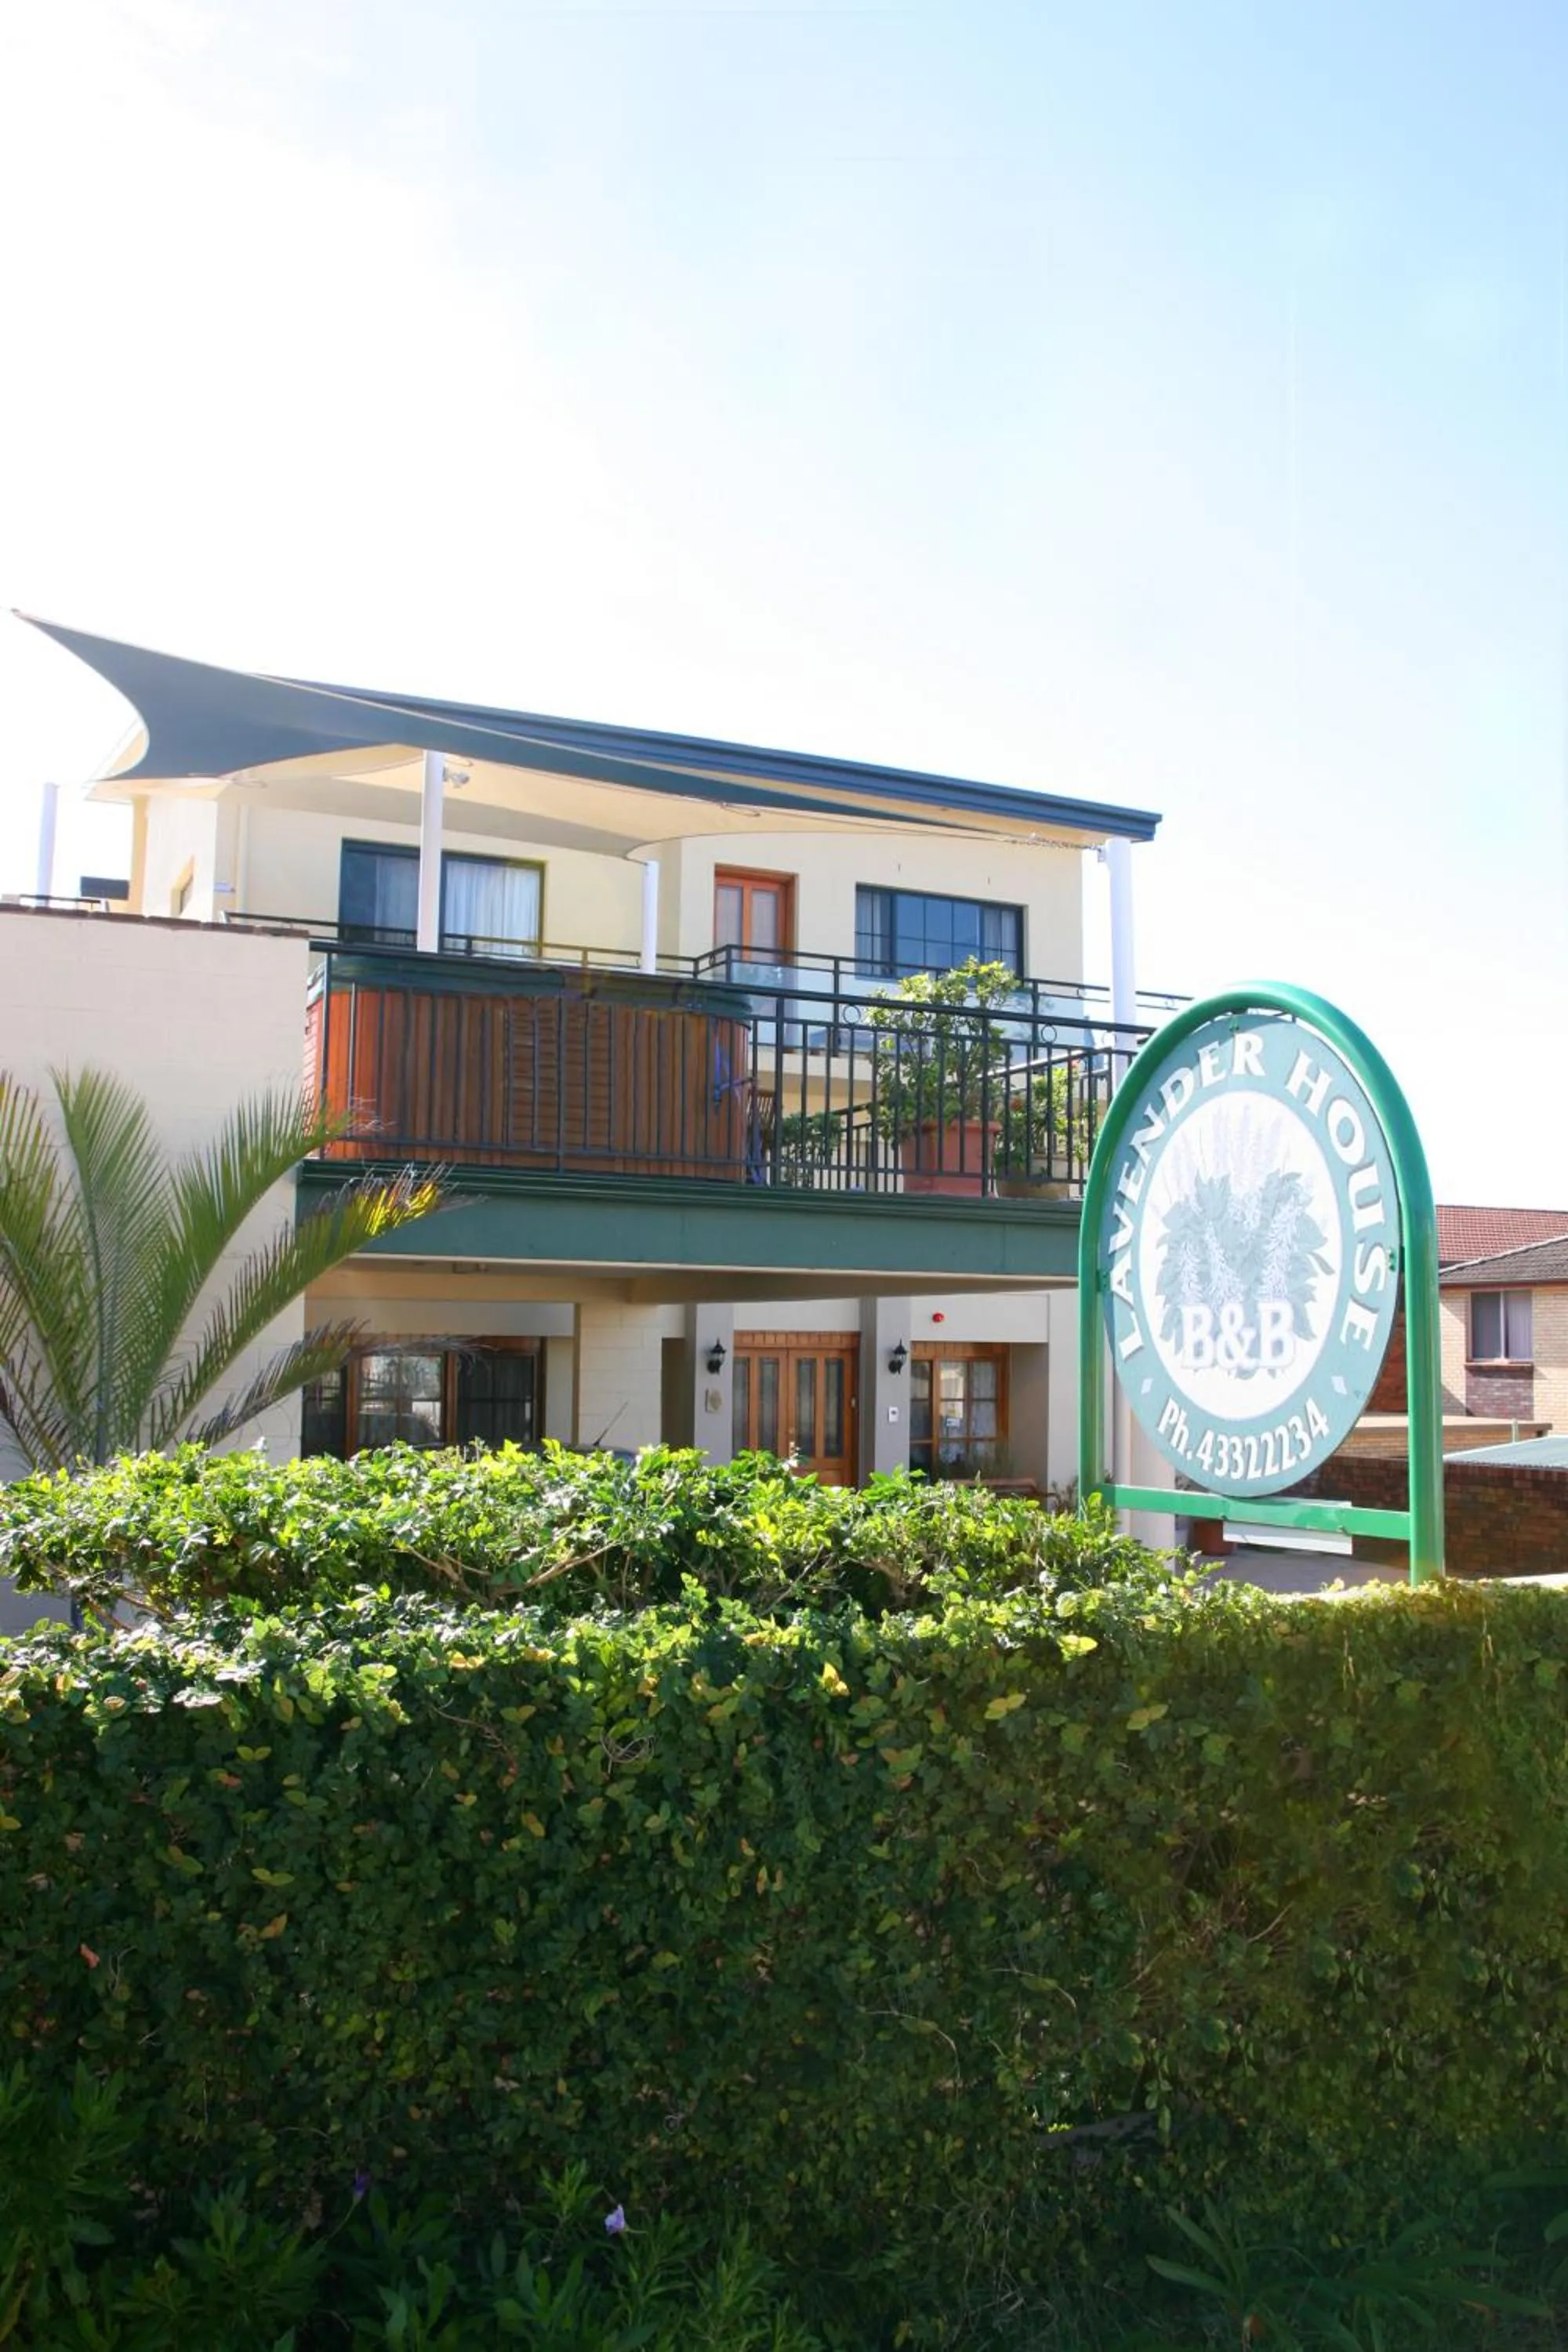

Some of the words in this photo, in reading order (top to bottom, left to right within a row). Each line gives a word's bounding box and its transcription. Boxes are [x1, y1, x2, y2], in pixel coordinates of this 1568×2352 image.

[1109, 1032, 1265, 1361] LAVENDER
[1285, 1051, 1385, 1351] HOUSE
[1181, 1301, 1297, 1369] B&B
